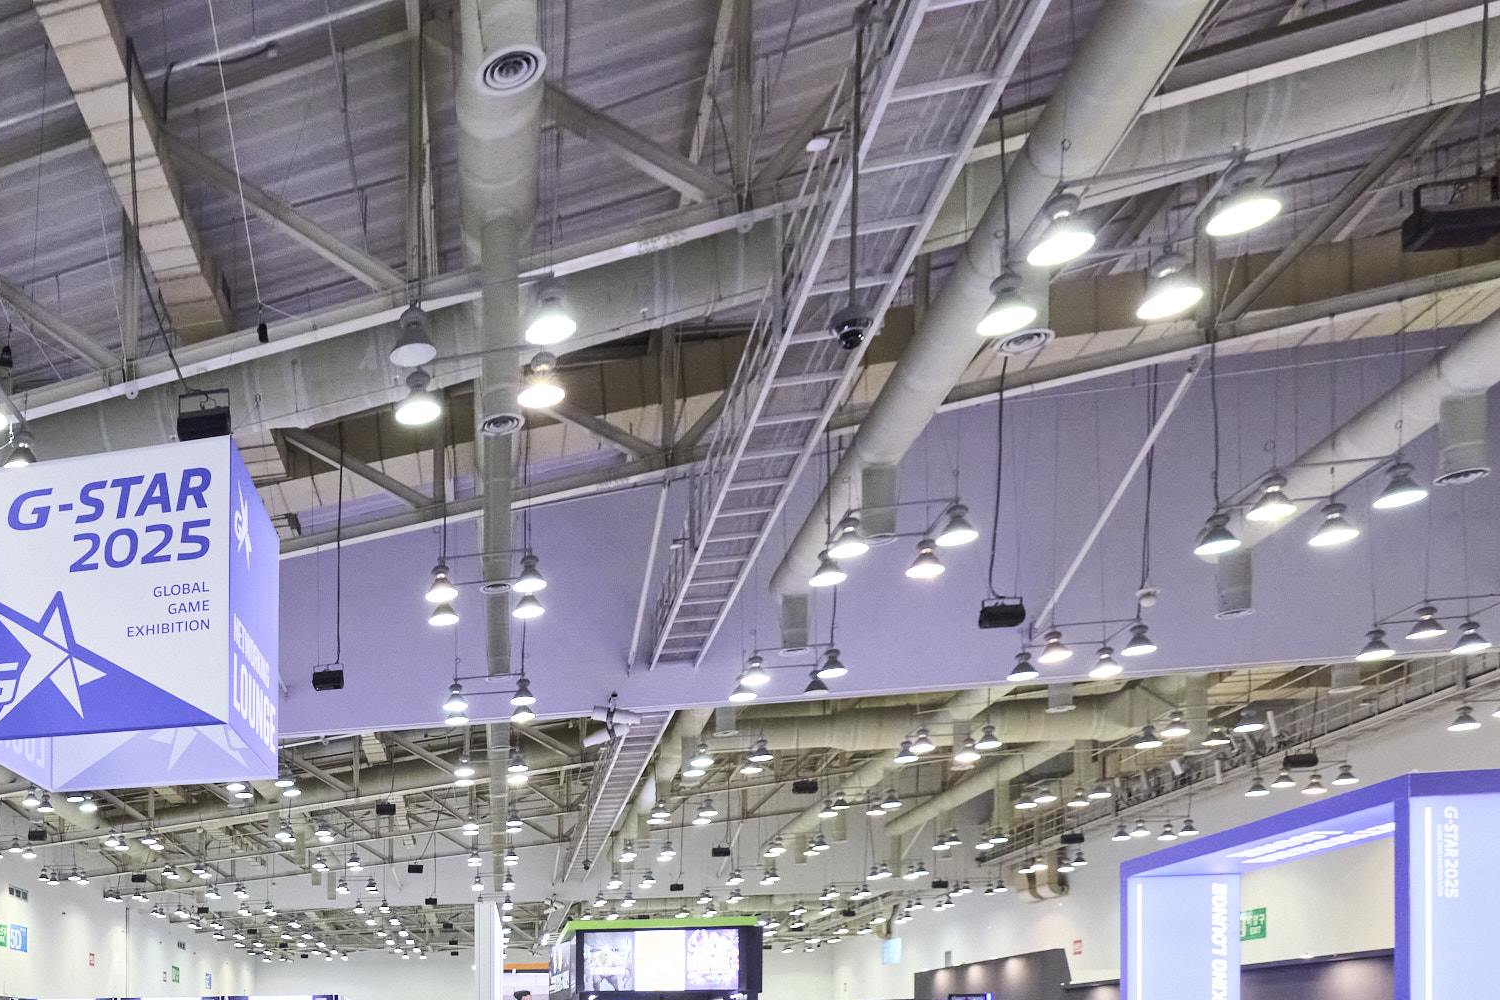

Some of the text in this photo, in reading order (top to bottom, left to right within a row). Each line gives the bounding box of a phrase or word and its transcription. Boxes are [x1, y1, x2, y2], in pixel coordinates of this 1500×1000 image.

[7, 467, 212, 531] G-STAR
[69, 519, 211, 573] 2025
[153, 581, 210, 598] GLOBAL
[168, 600, 210, 615] GAME
[127, 619, 211, 638] EXHIBITION
[233, 612, 270, 689] NETWORKING
[233, 652, 276, 754] LOUNGE
[1444, 805, 1459, 898] G-STAR 2025
[10, 929, 22, 949] 5D
[1211, 882, 1228, 957] LOUNGE
